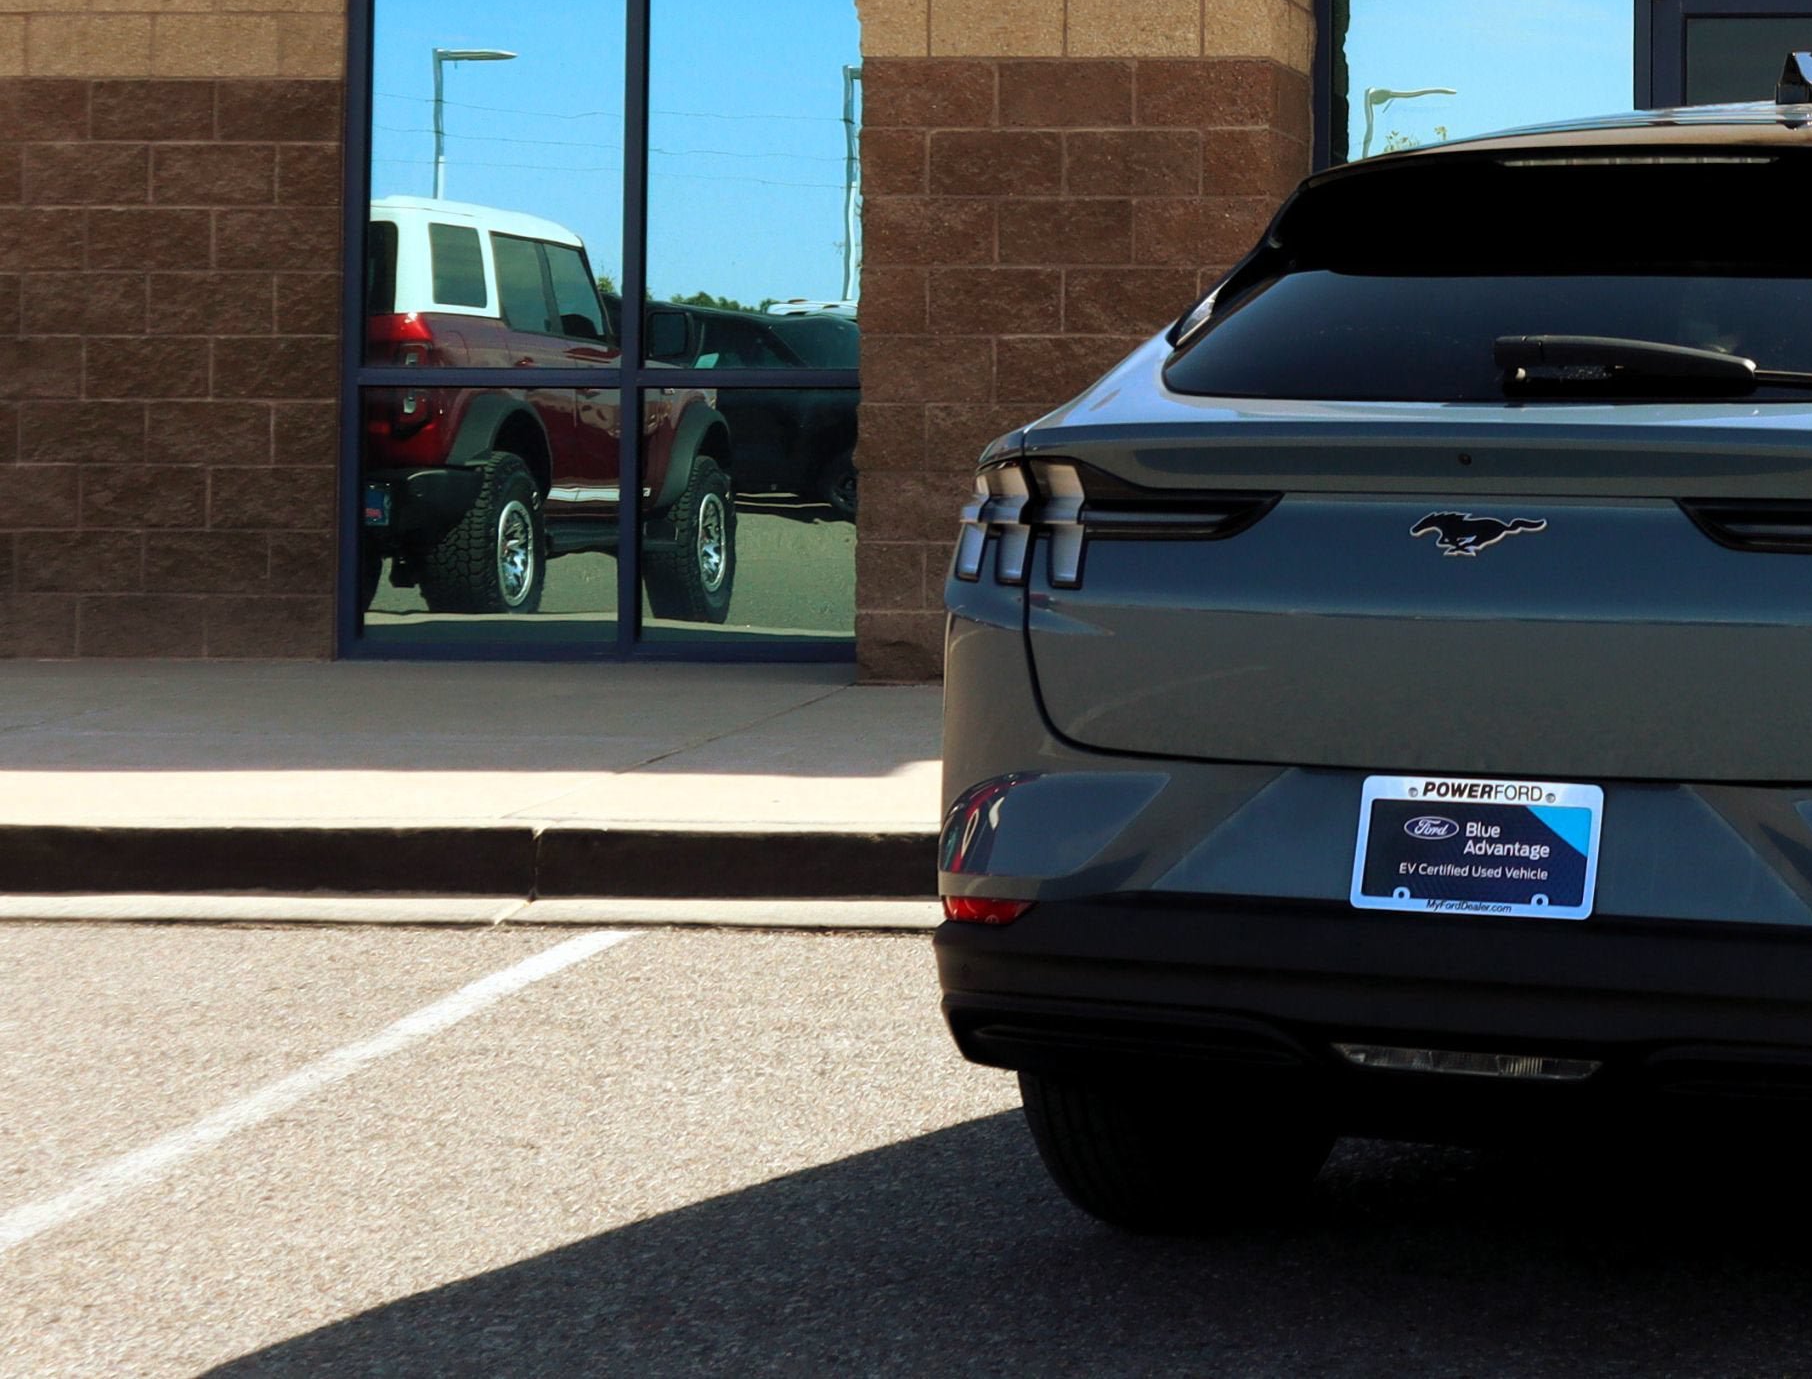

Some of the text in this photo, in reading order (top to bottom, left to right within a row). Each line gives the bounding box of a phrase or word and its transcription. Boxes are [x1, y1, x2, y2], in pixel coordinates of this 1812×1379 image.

[1414, 819, 1448, 836] Ford
[1466, 822, 1500, 838] Blue
[1463, 839, 1550, 860] Advantage
[1399, 863, 1548, 880] EV Certified Used Vehicle
[1426, 900, 1512, 913] MyFordDealer.com
